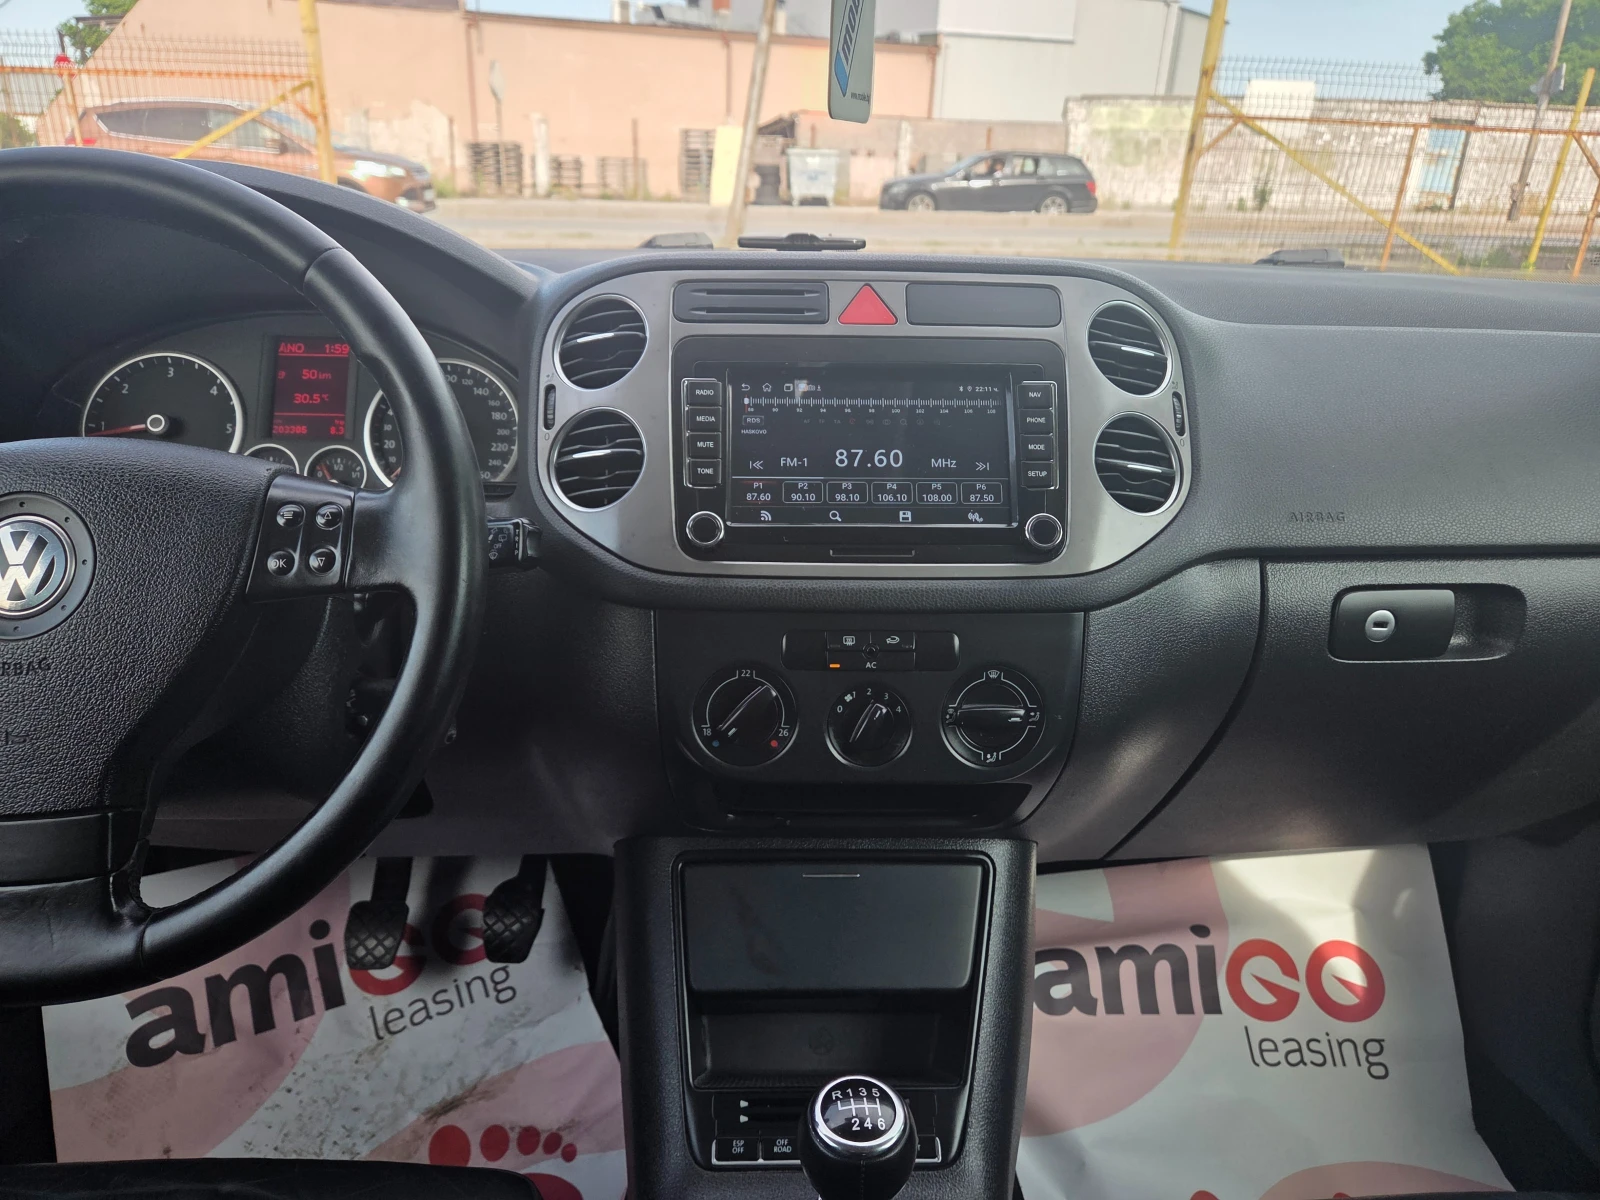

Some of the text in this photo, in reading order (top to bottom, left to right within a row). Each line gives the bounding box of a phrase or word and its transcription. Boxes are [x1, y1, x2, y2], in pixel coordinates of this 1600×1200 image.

[166, 367, 174, 378] 3
[302, 368, 318, 379] 50
[121, 383, 129, 394] 2
[210, 385, 219, 396] 4
[473, 387, 489, 396] 140
[293, 393, 320, 404] 30.5
[491, 411, 507, 420] 180
[100, 421, 105, 431] 1
[225, 423, 233, 434] 5
[383, 440, 396, 448] 20
[490, 443, 509, 452] 220
[780, 449, 957, 468] FM-1 87.60 MHz
[746, 493, 771, 501] 87.60
[791, 493, 816, 501] 90.10
[878, 494, 907, 502] 106.10
[922, 494, 952, 502] 108.00
[969, 494, 994, 502] 87.50
[1290, 511, 1346, 523] AIRBAG
[270, 558, 287, 569] OK
[866, 688, 872, 696] 2
[884, 692, 889, 700] 3
[837, 705, 843, 713] 0
[703, 728, 712, 736] 18
[778, 728, 789, 737] 26
[370, 964, 518, 1040] leasing
[1244, 1026, 1390, 1080] leasing
[832, 1088, 880, 1099] R 1 3 5
[852, 1118, 886, 1131] 2 4 6
